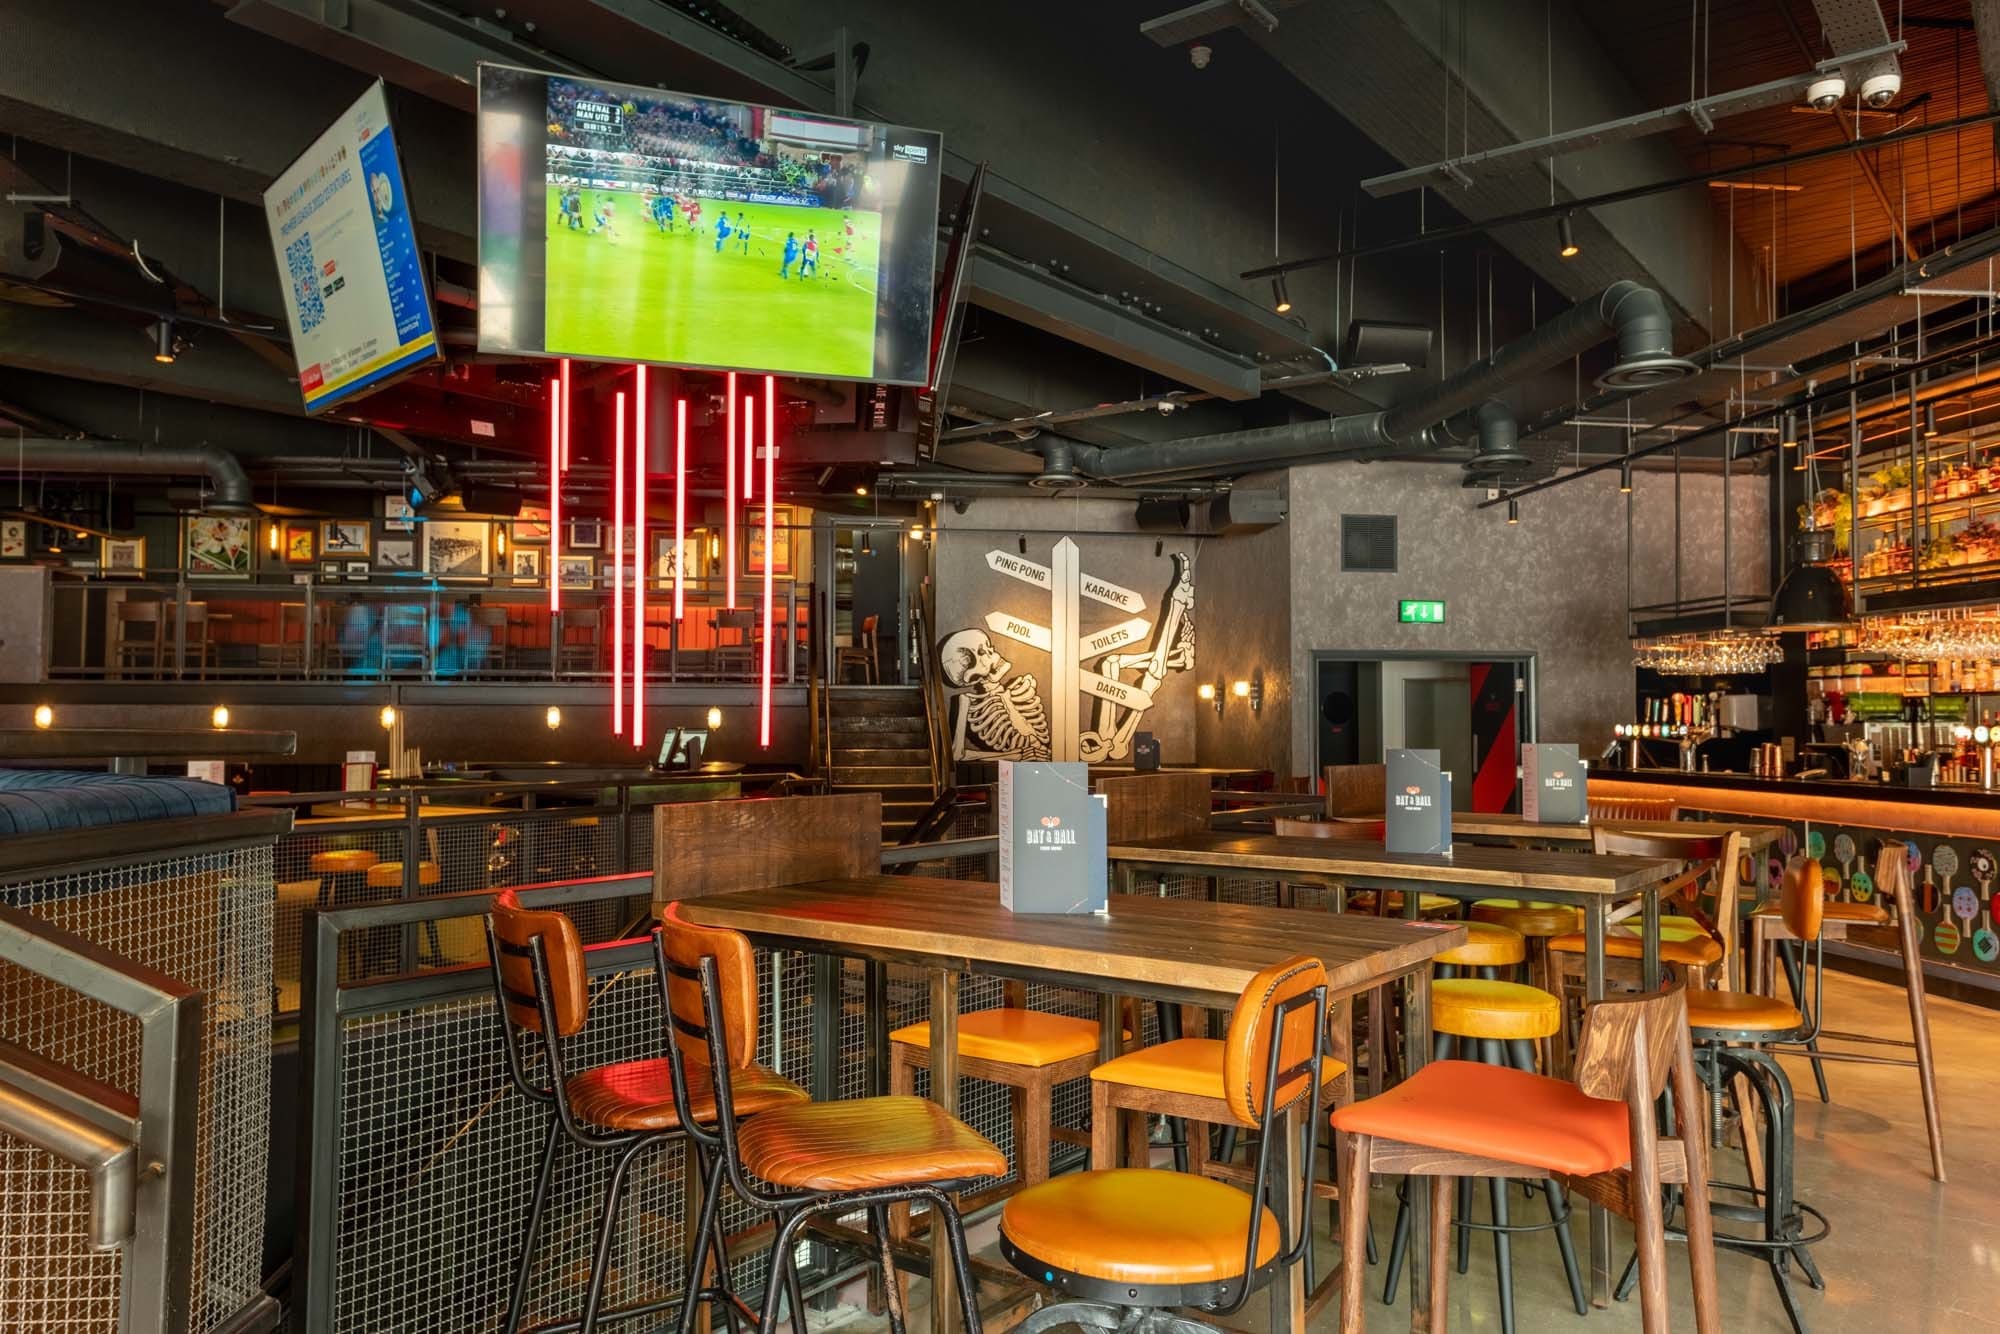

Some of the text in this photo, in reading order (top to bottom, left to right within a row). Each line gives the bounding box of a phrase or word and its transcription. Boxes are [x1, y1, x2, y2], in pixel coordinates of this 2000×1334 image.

[576, 102, 610, 114] ARSENAL
[576, 110, 594, 120] MAN
[595, 113, 610, 122] UTD
[995, 555, 1046, 582] PING PONG
[1085, 581, 1129, 606] KARAOKE
[1006, 621, 1031, 639] POOL
[1091, 629, 1129, 651] TOILETS
[1096, 681, 1127, 700] DARTS
[1026, 829, 1045, 844] BAT
[1053, 829, 1077, 844] BALL
